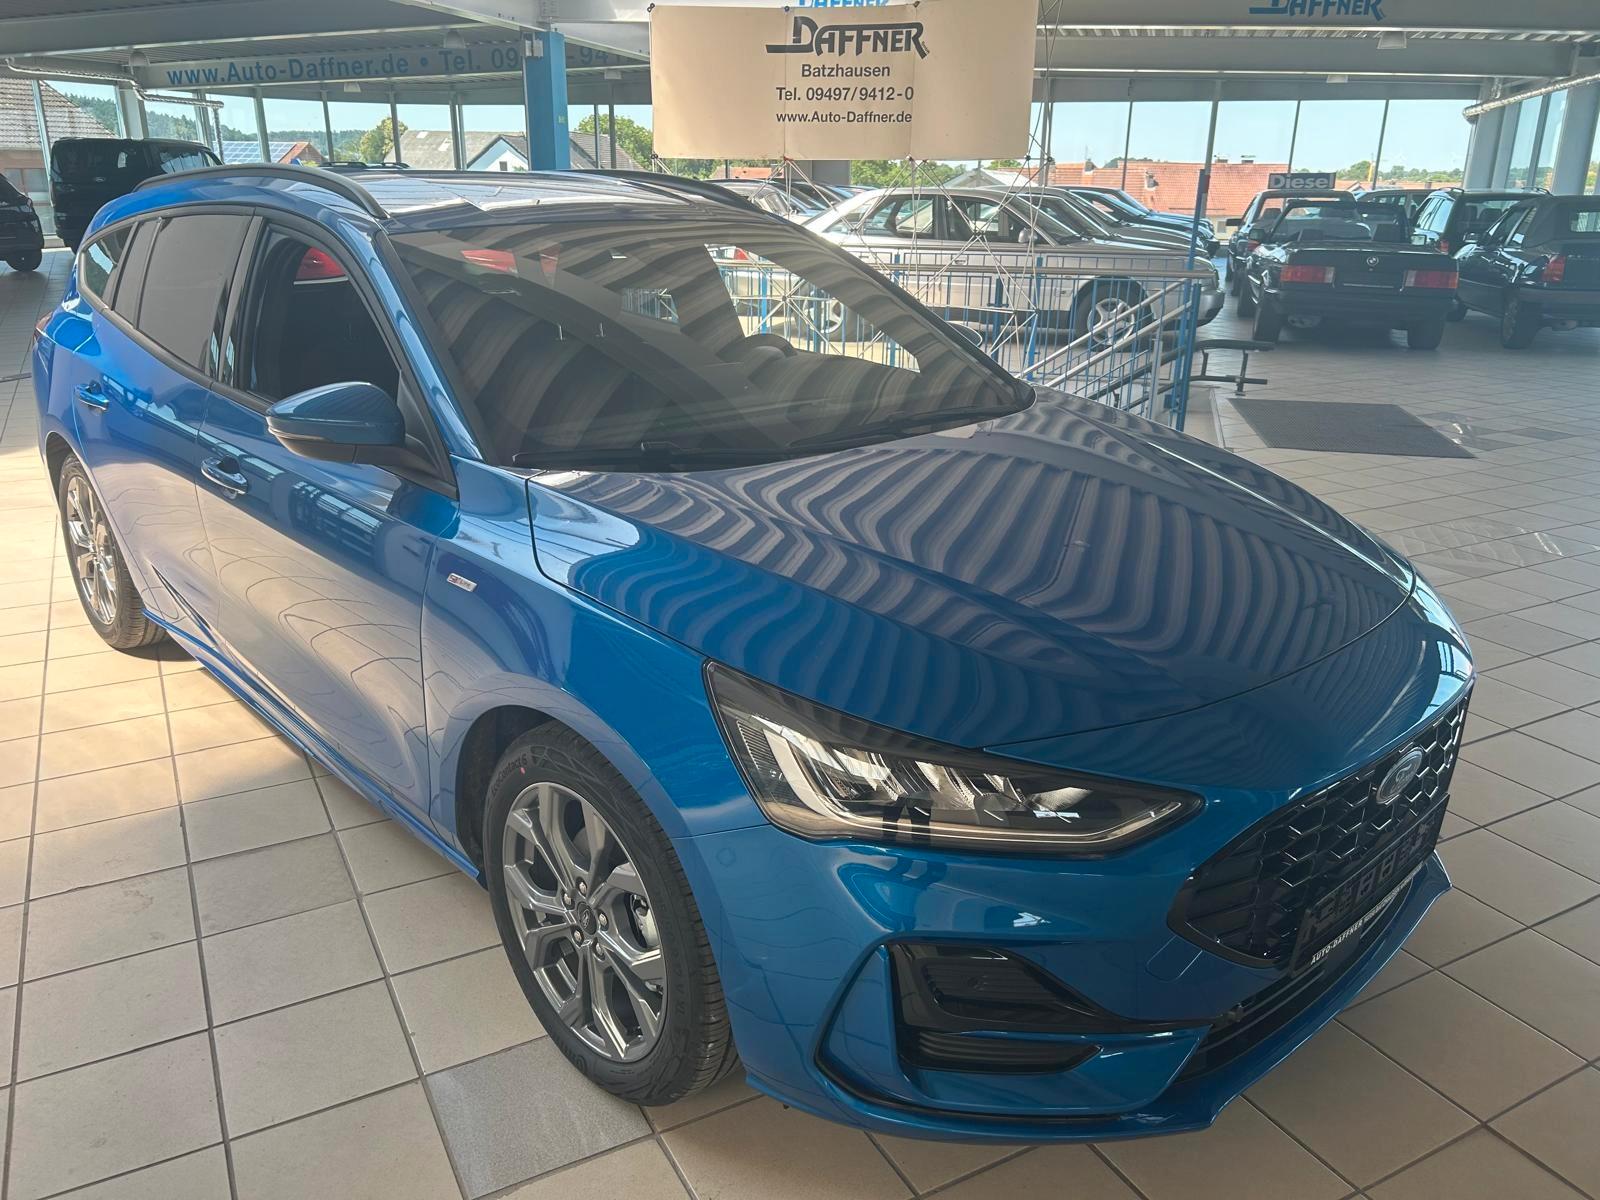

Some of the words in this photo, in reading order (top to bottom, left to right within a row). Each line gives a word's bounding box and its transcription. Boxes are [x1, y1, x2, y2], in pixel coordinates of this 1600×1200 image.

[766, 16, 928, 60] DAFFNER
[166, 53, 409, 85] www.Auto-Daffner.de
[438, 50, 481, 72] Tel.
[801, 63, 891, 78] Batzhausen
[776, 87, 801, 101] Tel.
[776, 111, 913, 123] www.Auto-Daffner.de
[1270, 173, 1335, 189] Diesel
